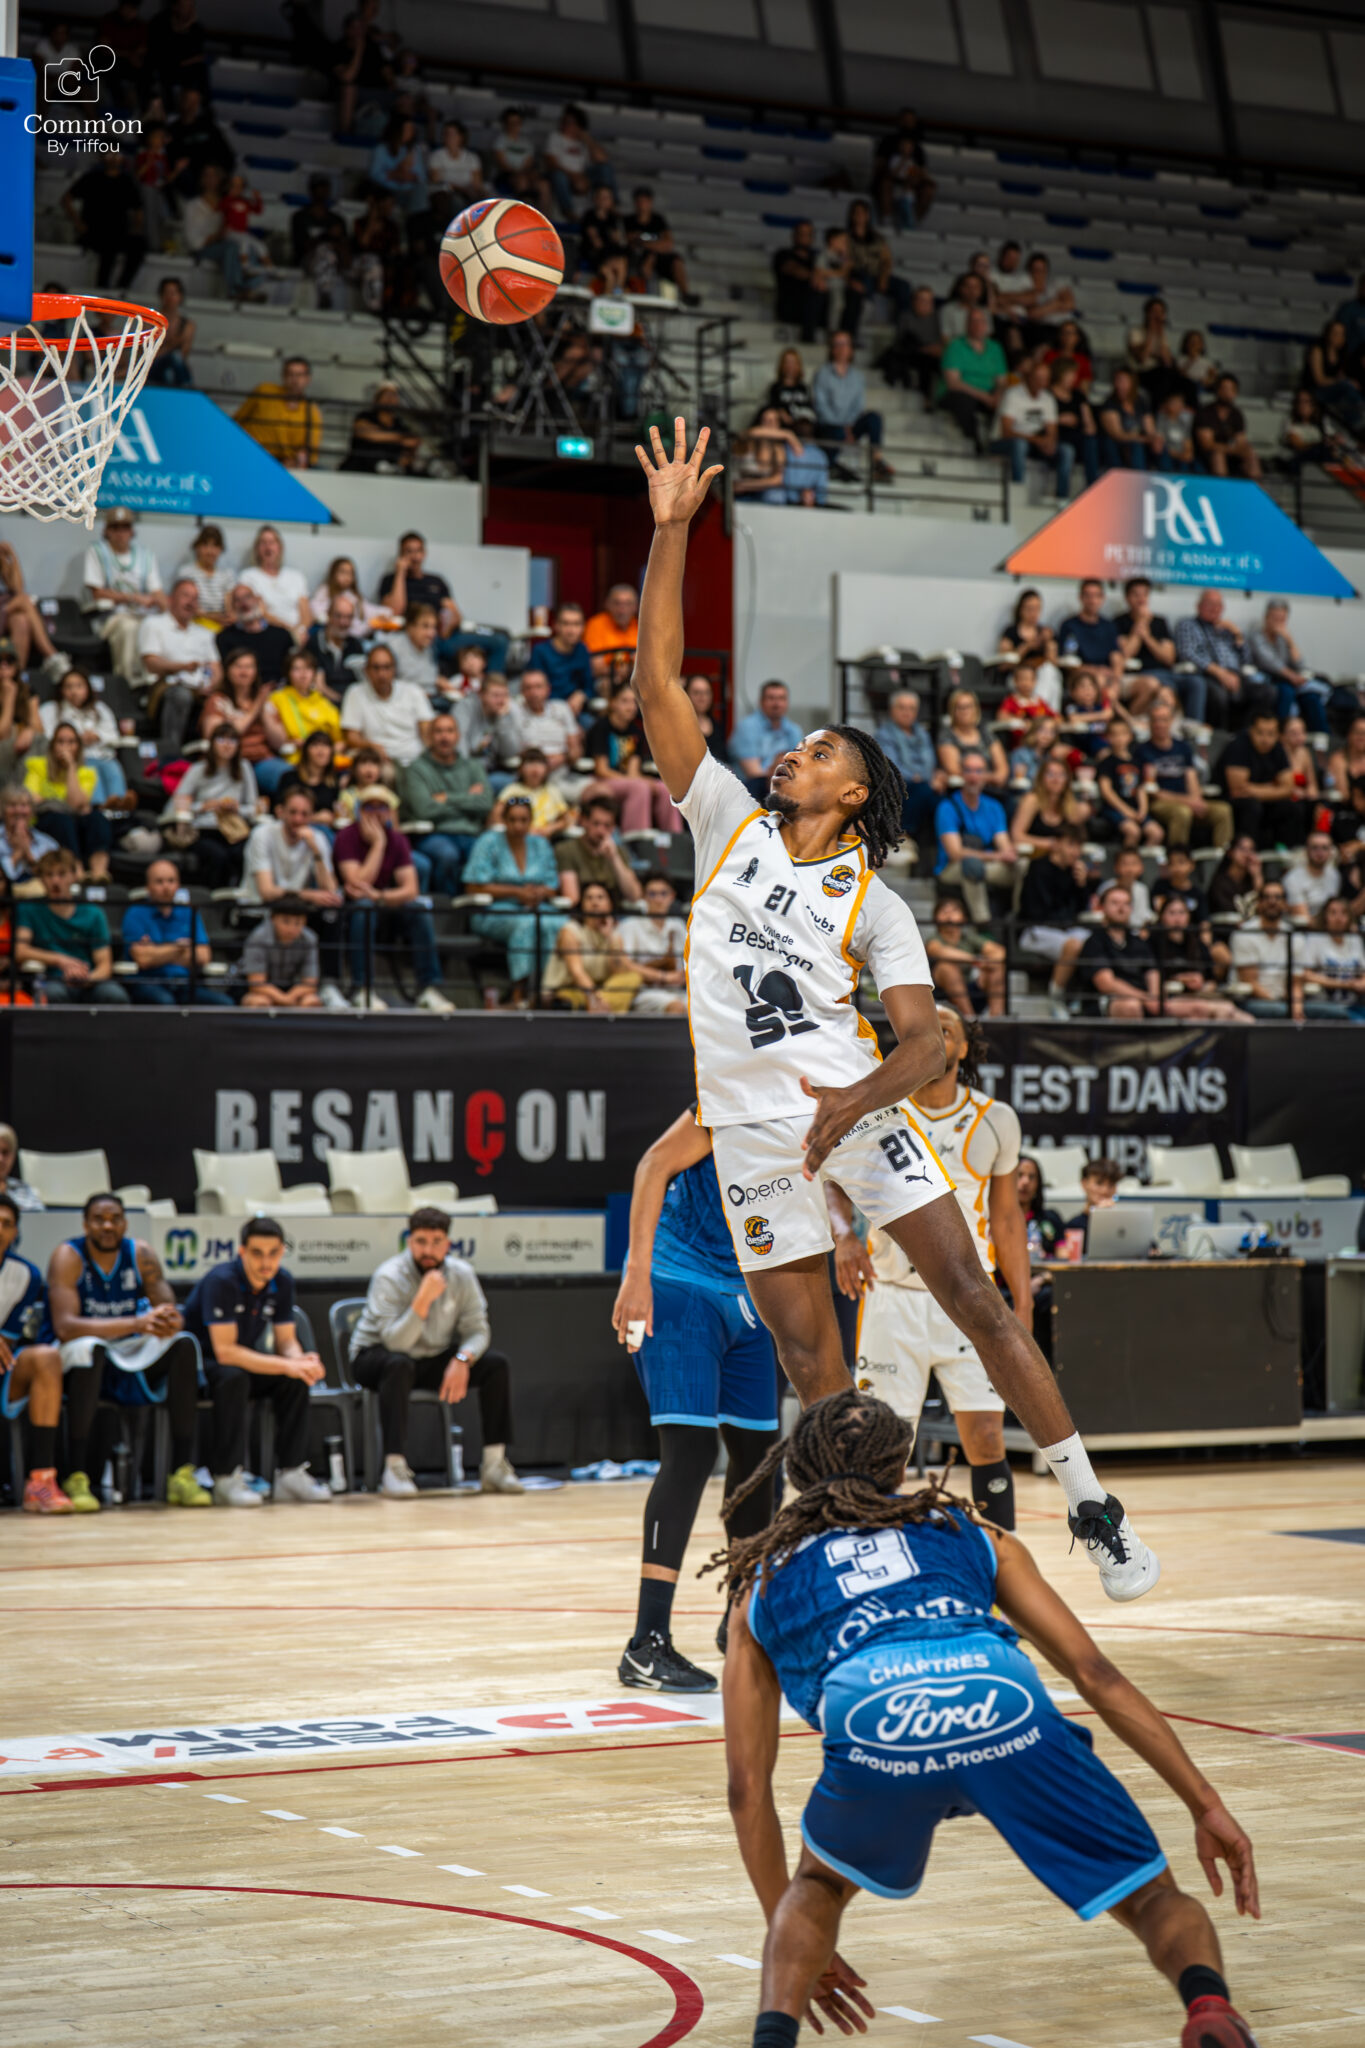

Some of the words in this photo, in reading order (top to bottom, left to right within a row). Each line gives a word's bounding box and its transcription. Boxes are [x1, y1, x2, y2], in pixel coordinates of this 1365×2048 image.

[764, 884, 797, 917] 21
[806, 905, 836, 933] ubs
[782, 934, 794, 946] de
[1011, 1065, 1098, 1114] EST
[1108, 1066, 1227, 1114] DANS
[215, 1089, 606, 1176] BESANÇON
[879, 1128, 925, 1173] 21
[728, 1177, 792, 1207] Opera
[824, 1528, 920, 1599] 3
[868, 1653, 990, 1686] CHARTRES
[876, 1684, 1000, 1743] Ford
[96, 1716, 456, 1748] FORM
[848, 1746, 920, 1777] Groupe
